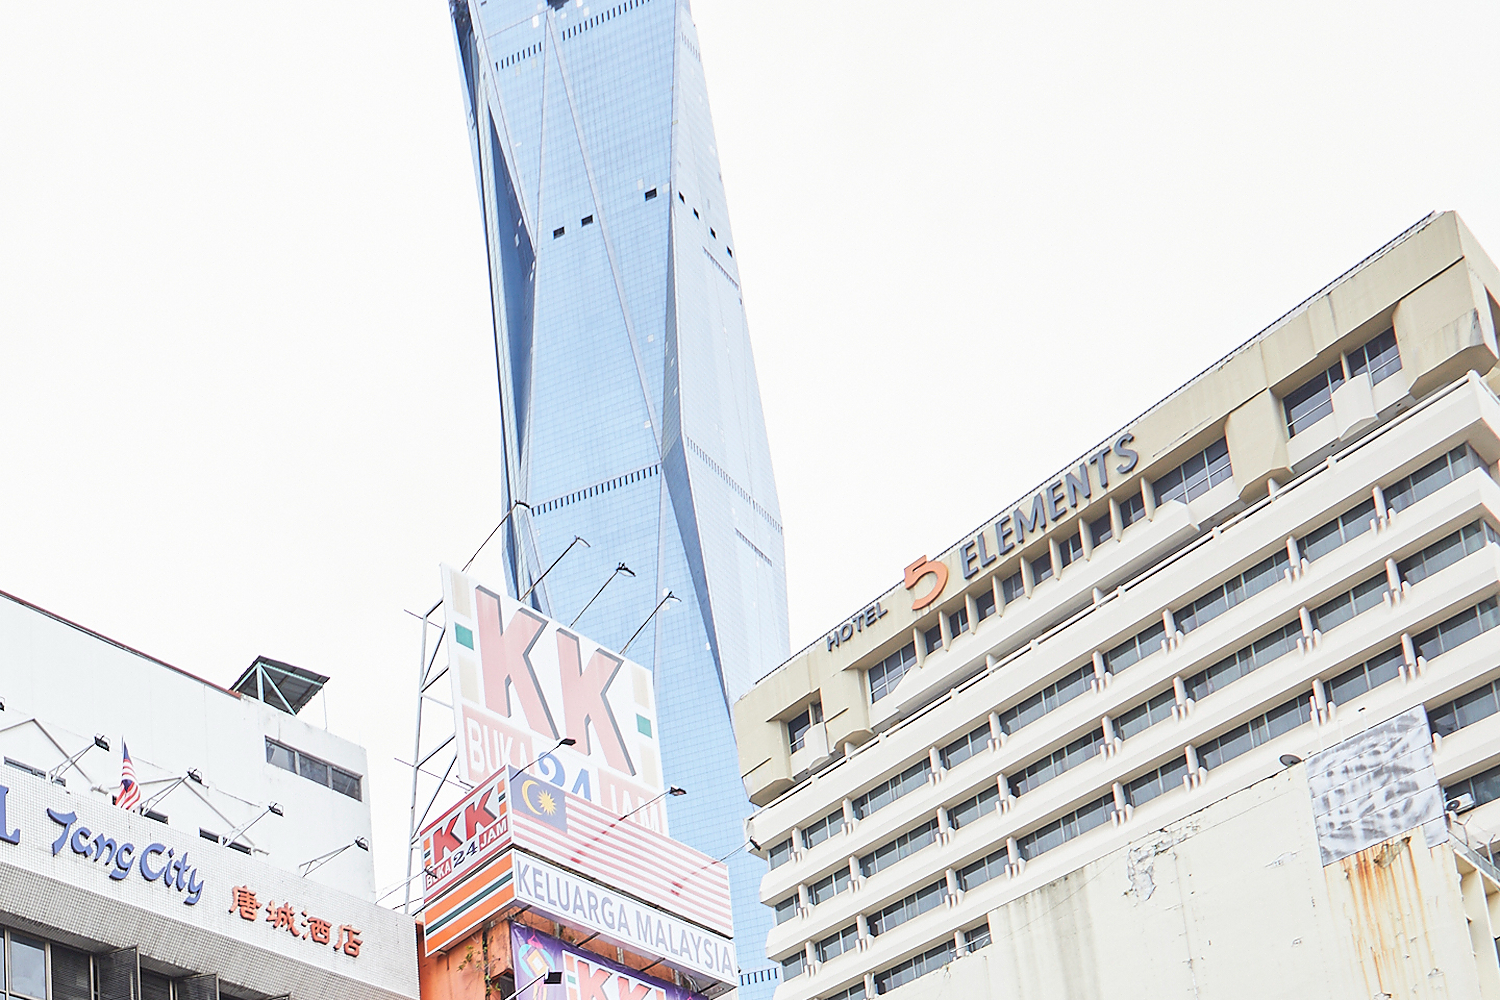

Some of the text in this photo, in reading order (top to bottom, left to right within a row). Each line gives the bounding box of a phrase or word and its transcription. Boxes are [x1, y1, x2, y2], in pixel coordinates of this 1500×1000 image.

[826, 432, 1140, 652] HOTEL 5 ELEMENTS
[476, 585, 636, 776] KK
[46, 807, 136, 881] Tang
[140, 842, 204, 905] City
[433, 786, 498, 863] KK
[453, 840, 478, 869] 24
[481, 821, 507, 848] JAM
[230, 883, 364, 957] 唐城酒店
[516, 860, 735, 978] KELUARGA MALAYSIA
